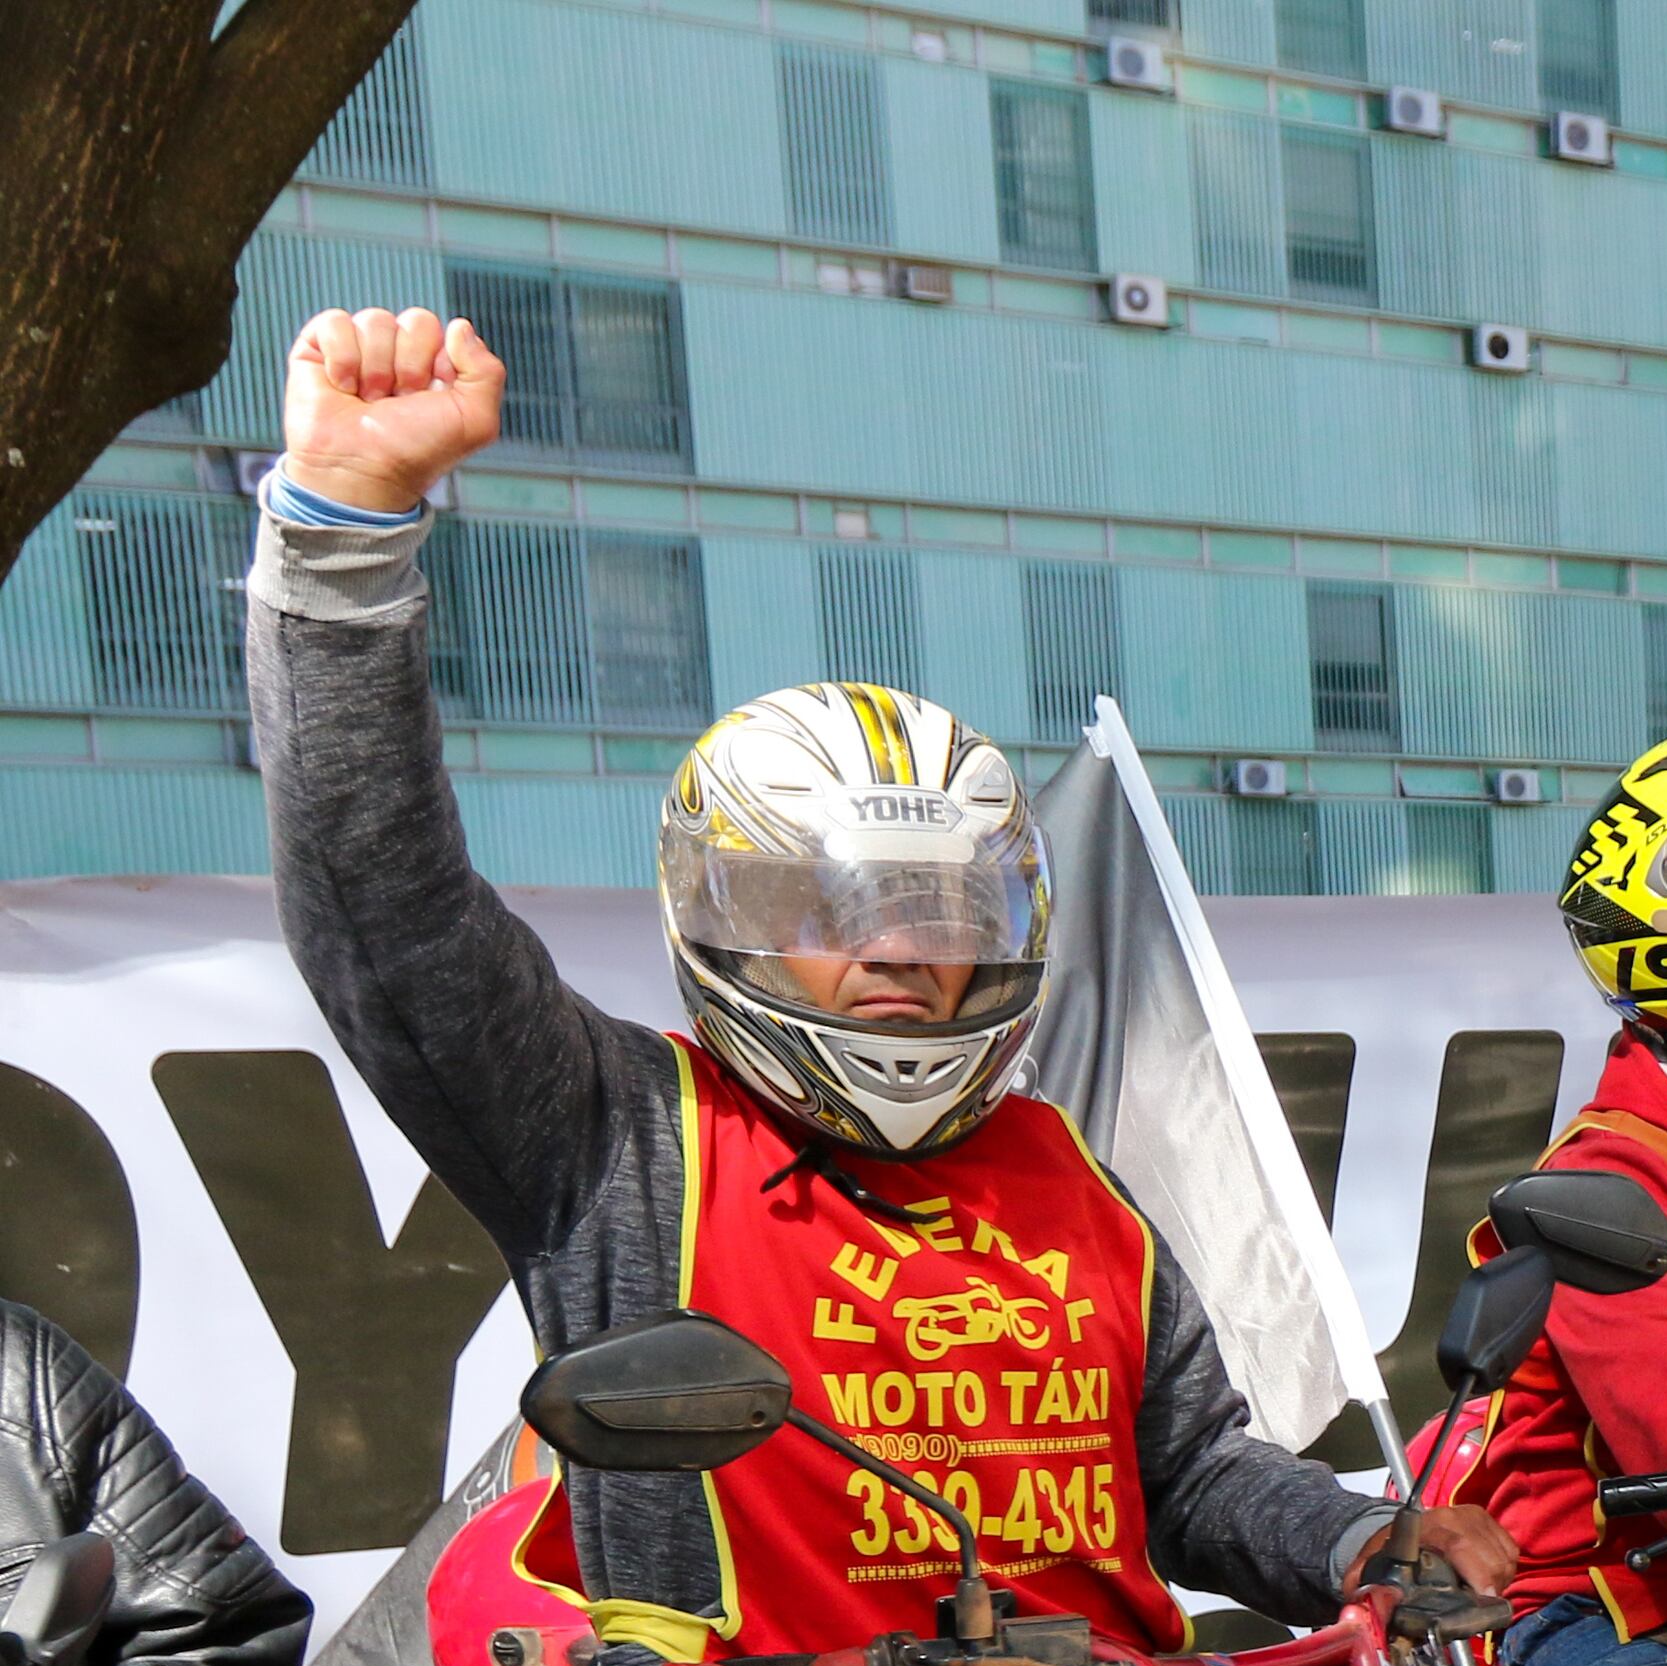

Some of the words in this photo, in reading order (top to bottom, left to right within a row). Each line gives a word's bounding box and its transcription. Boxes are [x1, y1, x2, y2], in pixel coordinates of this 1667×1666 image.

[849, 795, 947, 825] YOHE
[821, 1371, 987, 1428] MOTO
[1000, 1357, 1110, 1425] TÁXI
